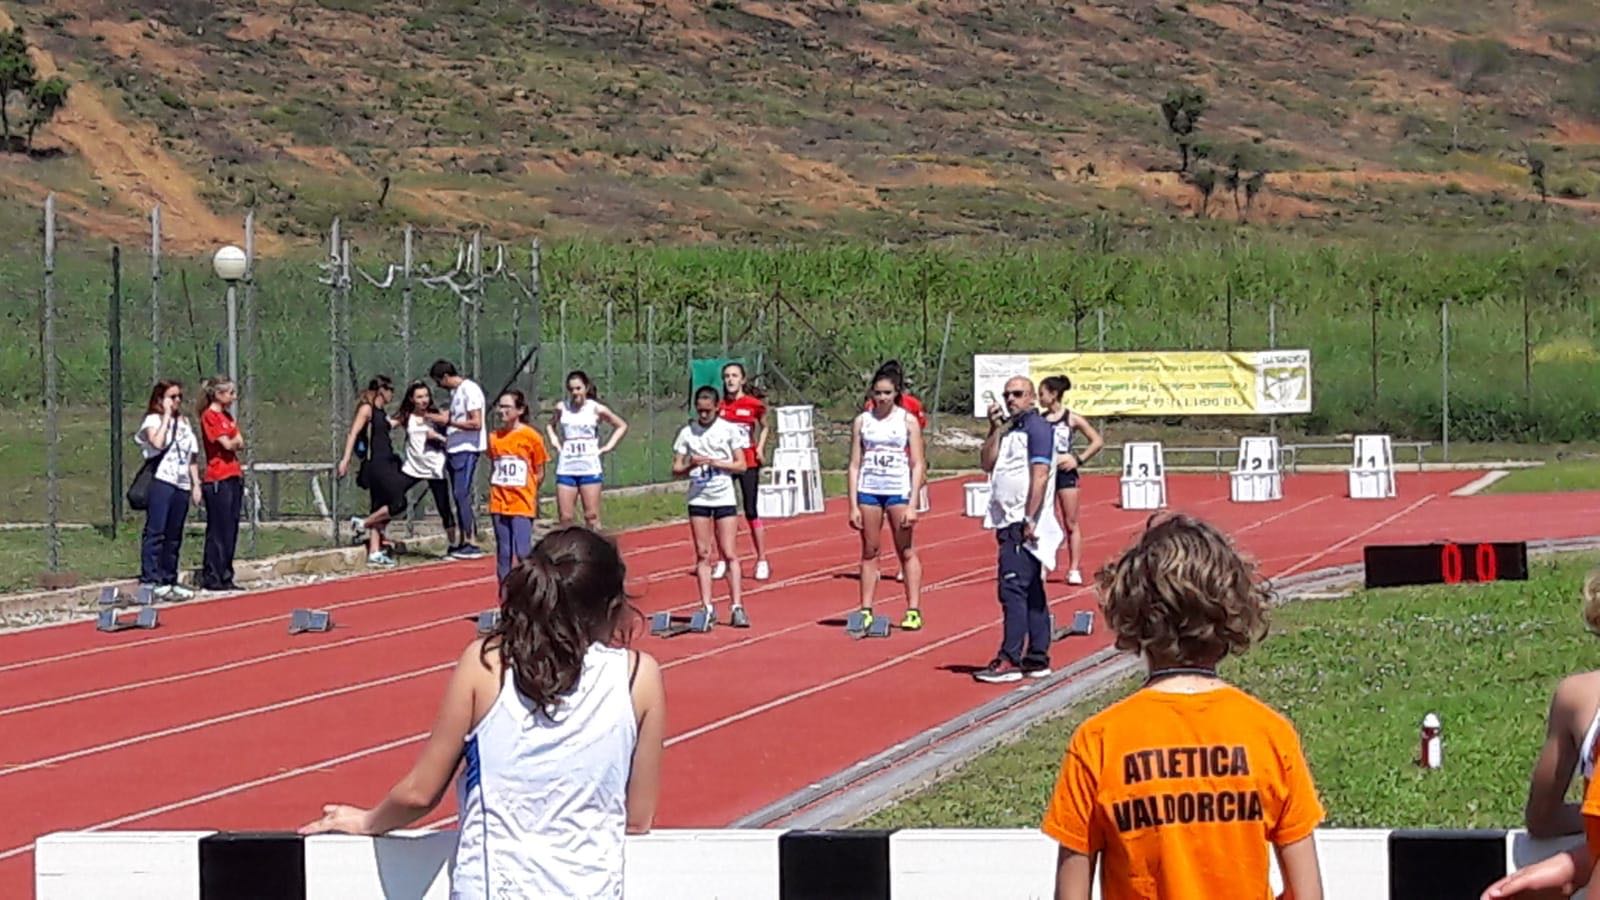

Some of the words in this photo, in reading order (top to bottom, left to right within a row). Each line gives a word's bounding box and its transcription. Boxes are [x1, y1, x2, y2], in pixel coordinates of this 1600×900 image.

[570, 443, 586, 454] 141
[873, 454, 895, 467] 142
[786, 469, 796, 485] 6
[1124, 745, 1250, 785] ATLETICA
[1112, 791, 1264, 833] VALDORCIA
